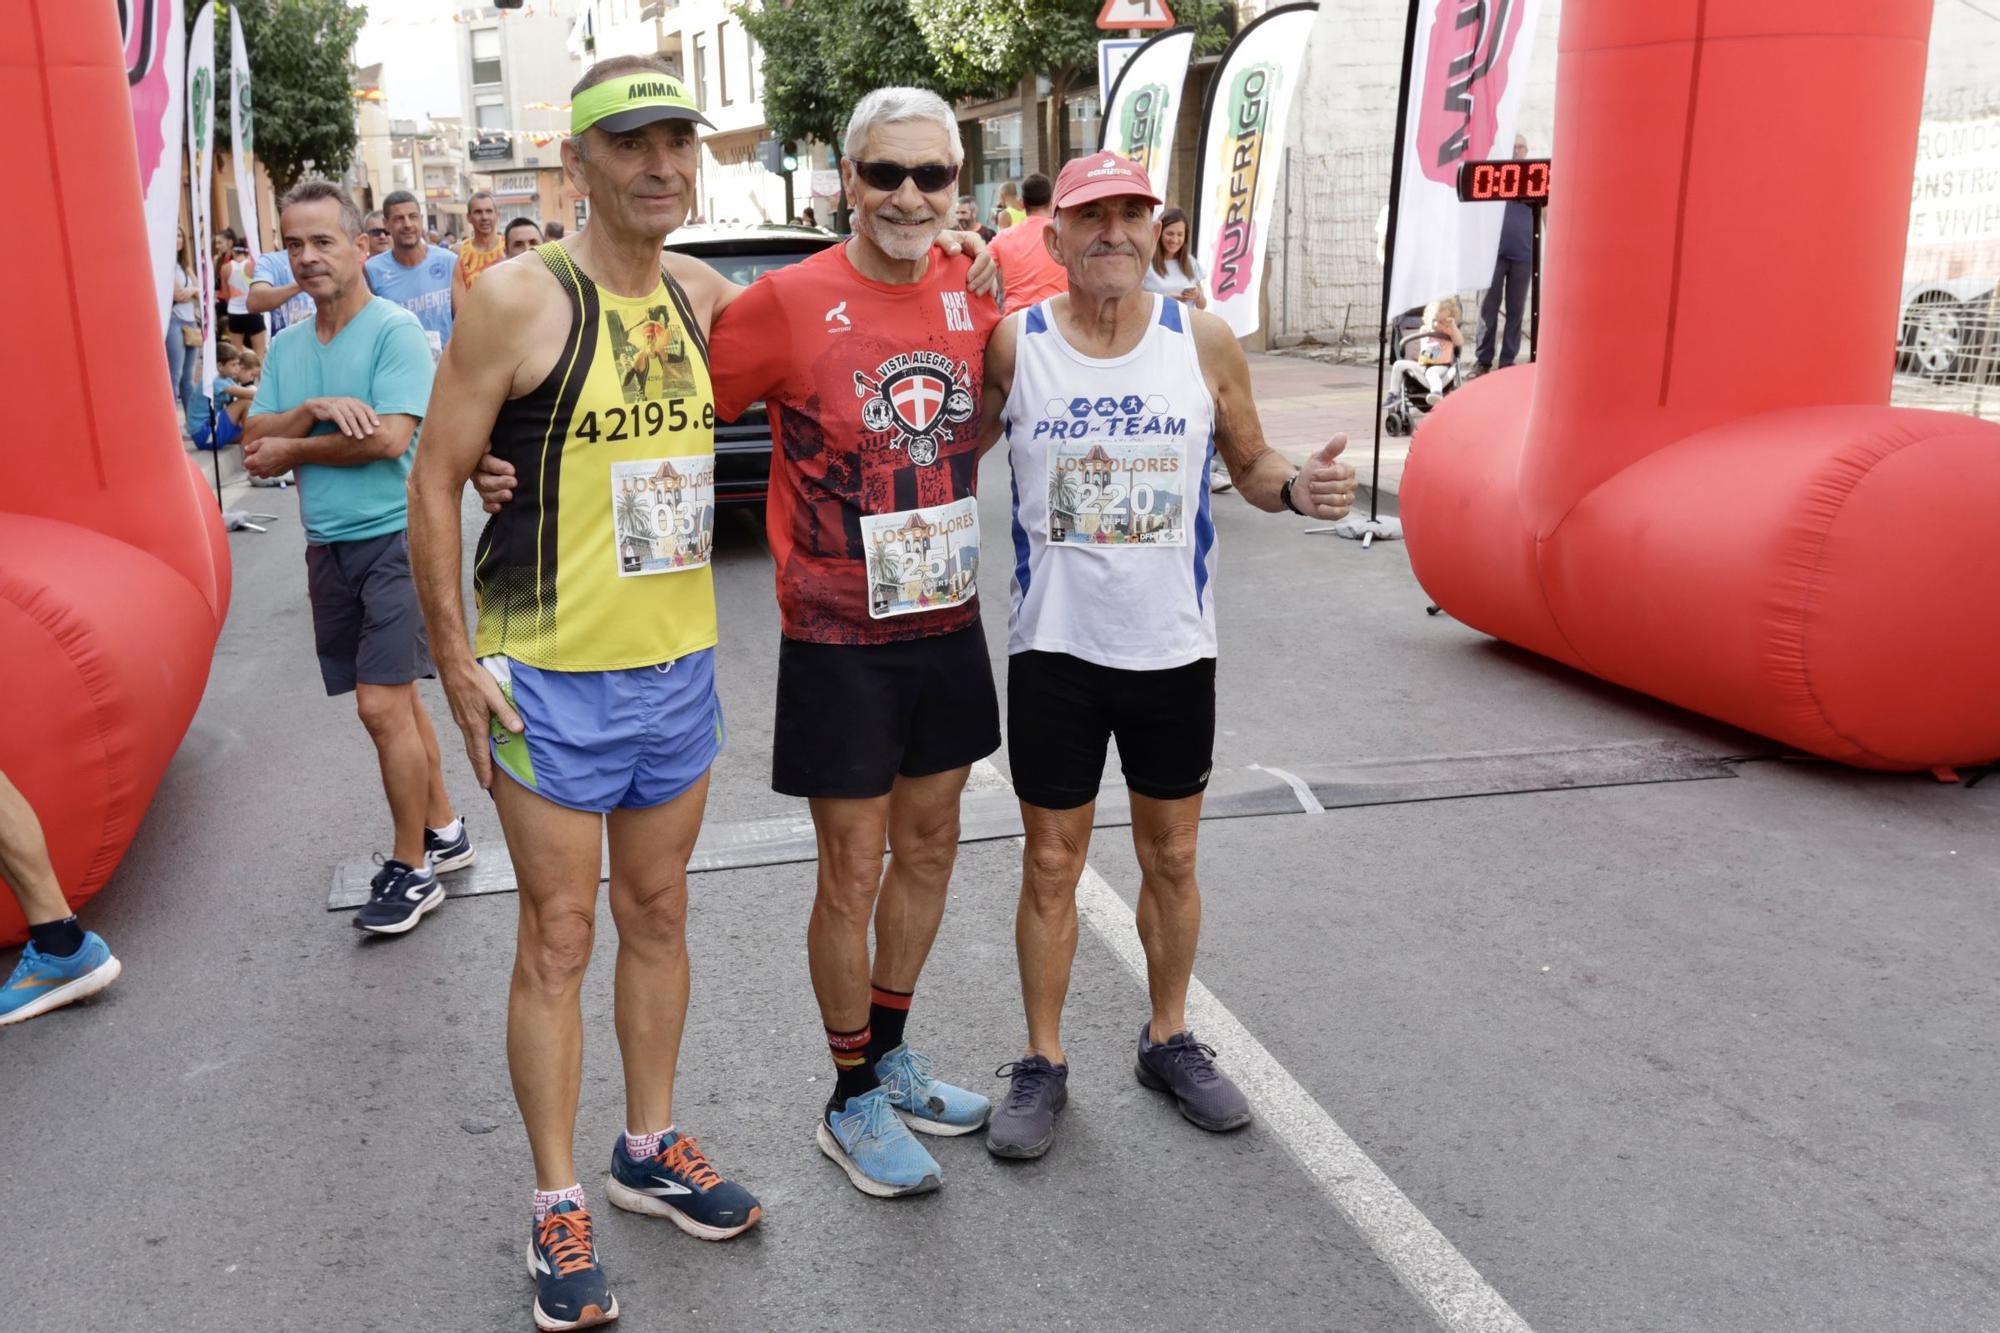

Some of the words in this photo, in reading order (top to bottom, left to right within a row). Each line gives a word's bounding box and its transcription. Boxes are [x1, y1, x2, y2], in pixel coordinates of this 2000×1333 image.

[628, 82, 681, 99] ANIMAL
[1218, 69, 1267, 294] MURFRIGO
[945, 308, 974, 332] ROJA
[878, 355, 909, 377] VISTA
[912, 352, 953, 373] ALEGRE
[1056, 457, 1087, 472] LOS
[1093, 457, 1180, 473] DOLORES
[623, 476, 657, 494] LOS
[663, 471, 714, 492] DOLORE
[1076, 483, 1154, 514] 220
[650, 501, 705, 537] 037
[872, 528, 905, 545] LOS
[912, 513, 974, 538] DOLORES
[900, 542, 962, 584] 251
